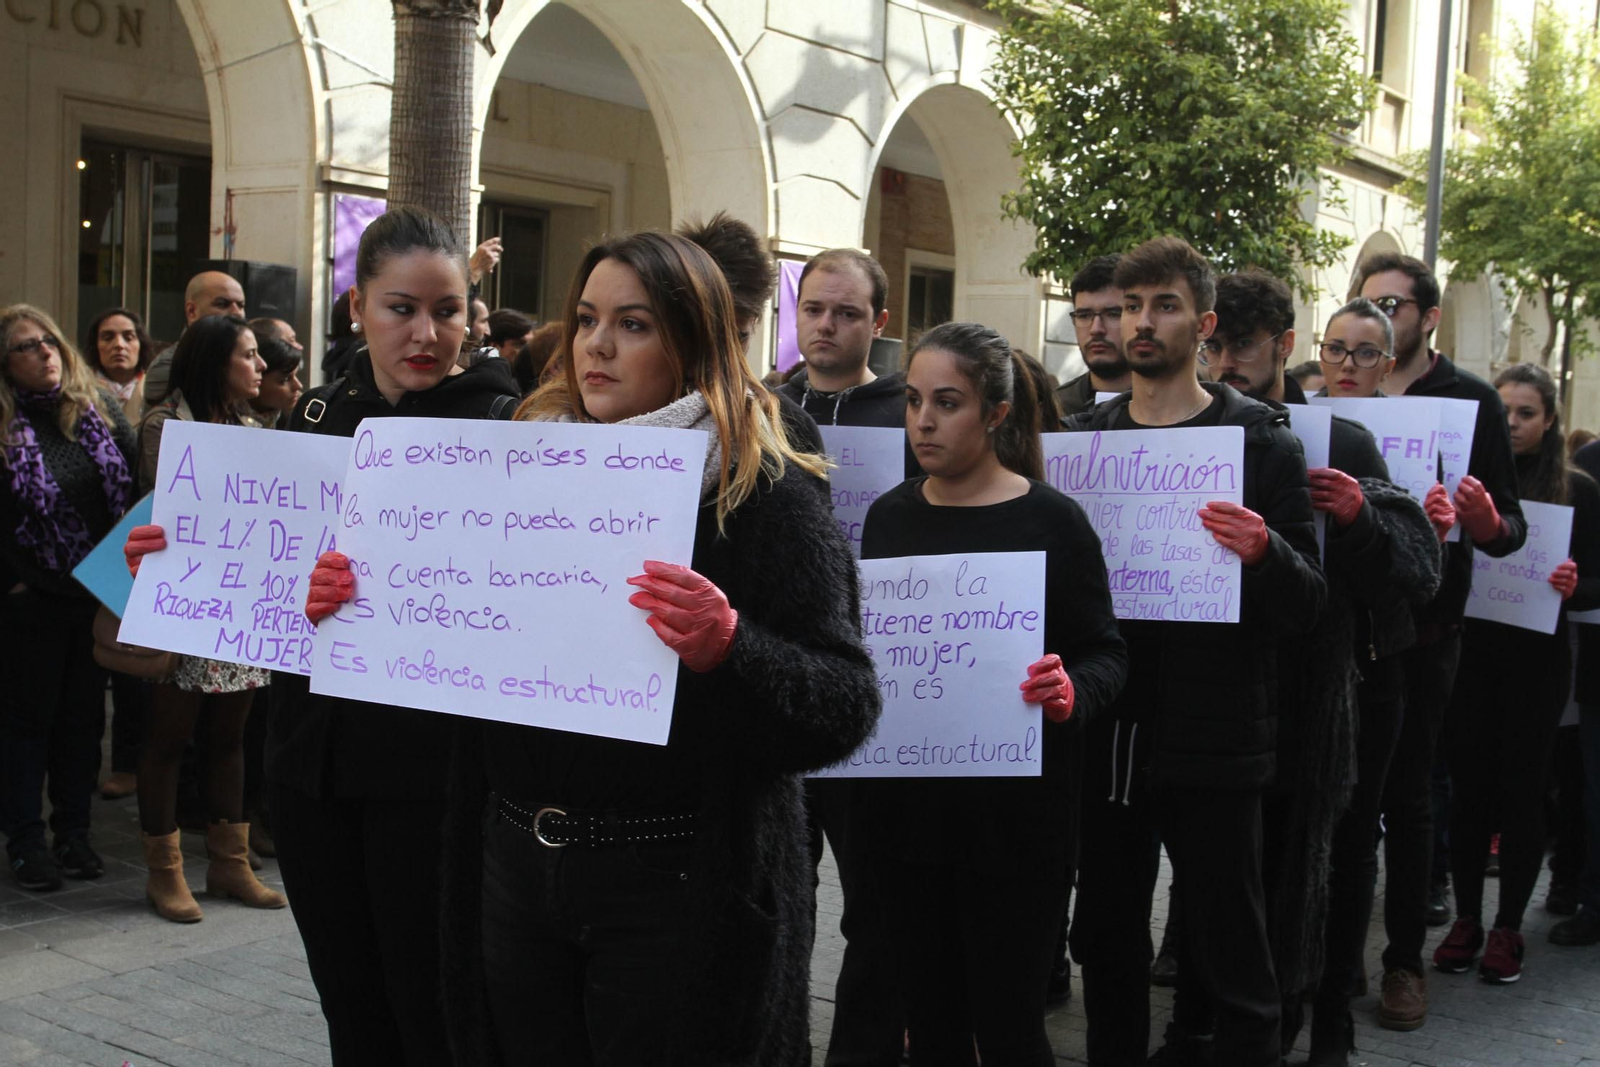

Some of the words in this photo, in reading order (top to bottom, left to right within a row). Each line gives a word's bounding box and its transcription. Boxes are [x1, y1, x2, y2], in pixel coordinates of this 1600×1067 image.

[355, 430, 394, 470] Que
[405, 436, 492, 465] existan
[506, 438, 587, 479] países
[604, 443, 686, 472] donde
[841, 447, 865, 467] EL
[1047, 430, 1236, 492] malnutrición
[168, 444, 202, 501] A
[224, 472, 307, 510] NIVEL
[321, 480, 343, 514] M
[344, 493, 364, 529] la
[379, 505, 450, 541] mujer
[461, 510, 493, 527] no
[504, 507, 575, 541] pueda
[589, 511, 661, 535] abrir
[176, 515, 206, 545] EL
[217, 518, 256, 550] 1%
[269, 519, 303, 562] DE
[1130, 534, 1154, 557] las
[1160, 534, 1202, 562] tasas
[1526, 542, 1547, 563] las
[220, 562, 247, 589] EL
[258, 570, 299, 604] 10%
[388, 556, 472, 590] cuenta
[490, 560, 608, 593] bancaria,
[956, 560, 987, 597] la
[1108, 561, 1174, 596] aterna,
[1180, 567, 1231, 595] ésto
[153, 581, 233, 623] RIQUEZA
[388, 593, 523, 633] violencia.
[862, 606, 933, 636] tiene
[942, 601, 1039, 633] nombre
[1113, 587, 1233, 622] estructural
[214, 627, 313, 672] MUJER
[886, 640, 976, 675] mujer,
[330, 641, 368, 674] Es
[386, 649, 486, 692] violencia
[500, 665, 661, 713] estructural.
[914, 678, 943, 699] es
[897, 726, 1037, 765] estructural.
